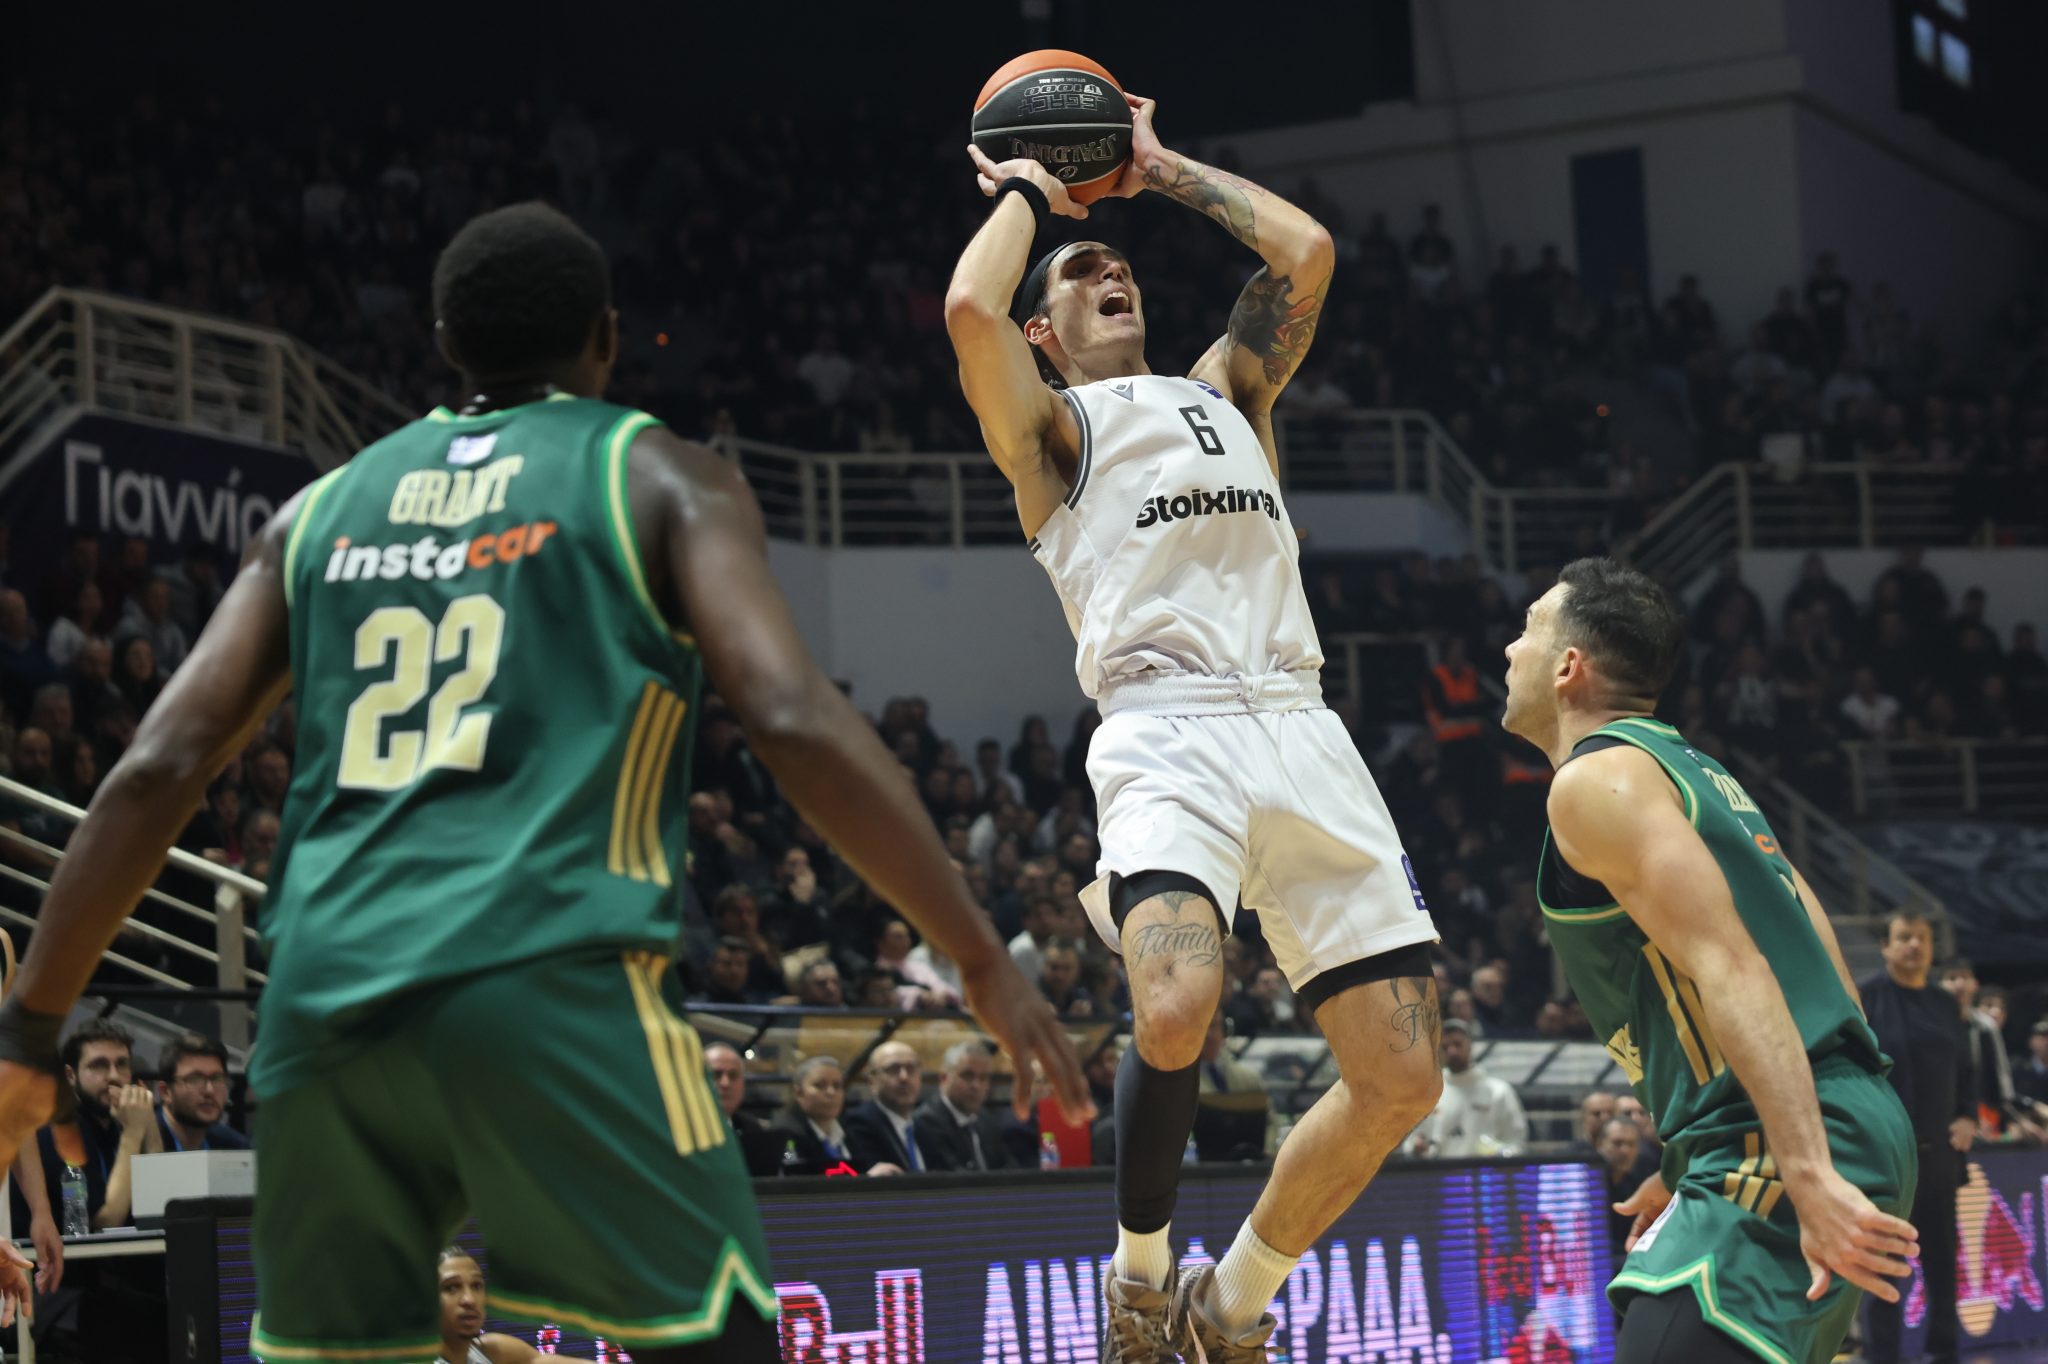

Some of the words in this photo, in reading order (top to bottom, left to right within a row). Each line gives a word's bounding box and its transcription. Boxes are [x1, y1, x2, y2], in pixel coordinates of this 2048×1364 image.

[1017, 94, 1112, 117] LEGACY
[1024, 84, 1083, 96] 1000
[1011, 134, 1117, 163] SPALDING
[1178, 404, 1225, 455] 6
[388, 453, 525, 527] GRANT
[324, 521, 558, 583] instacar
[337, 593, 506, 791] 22
